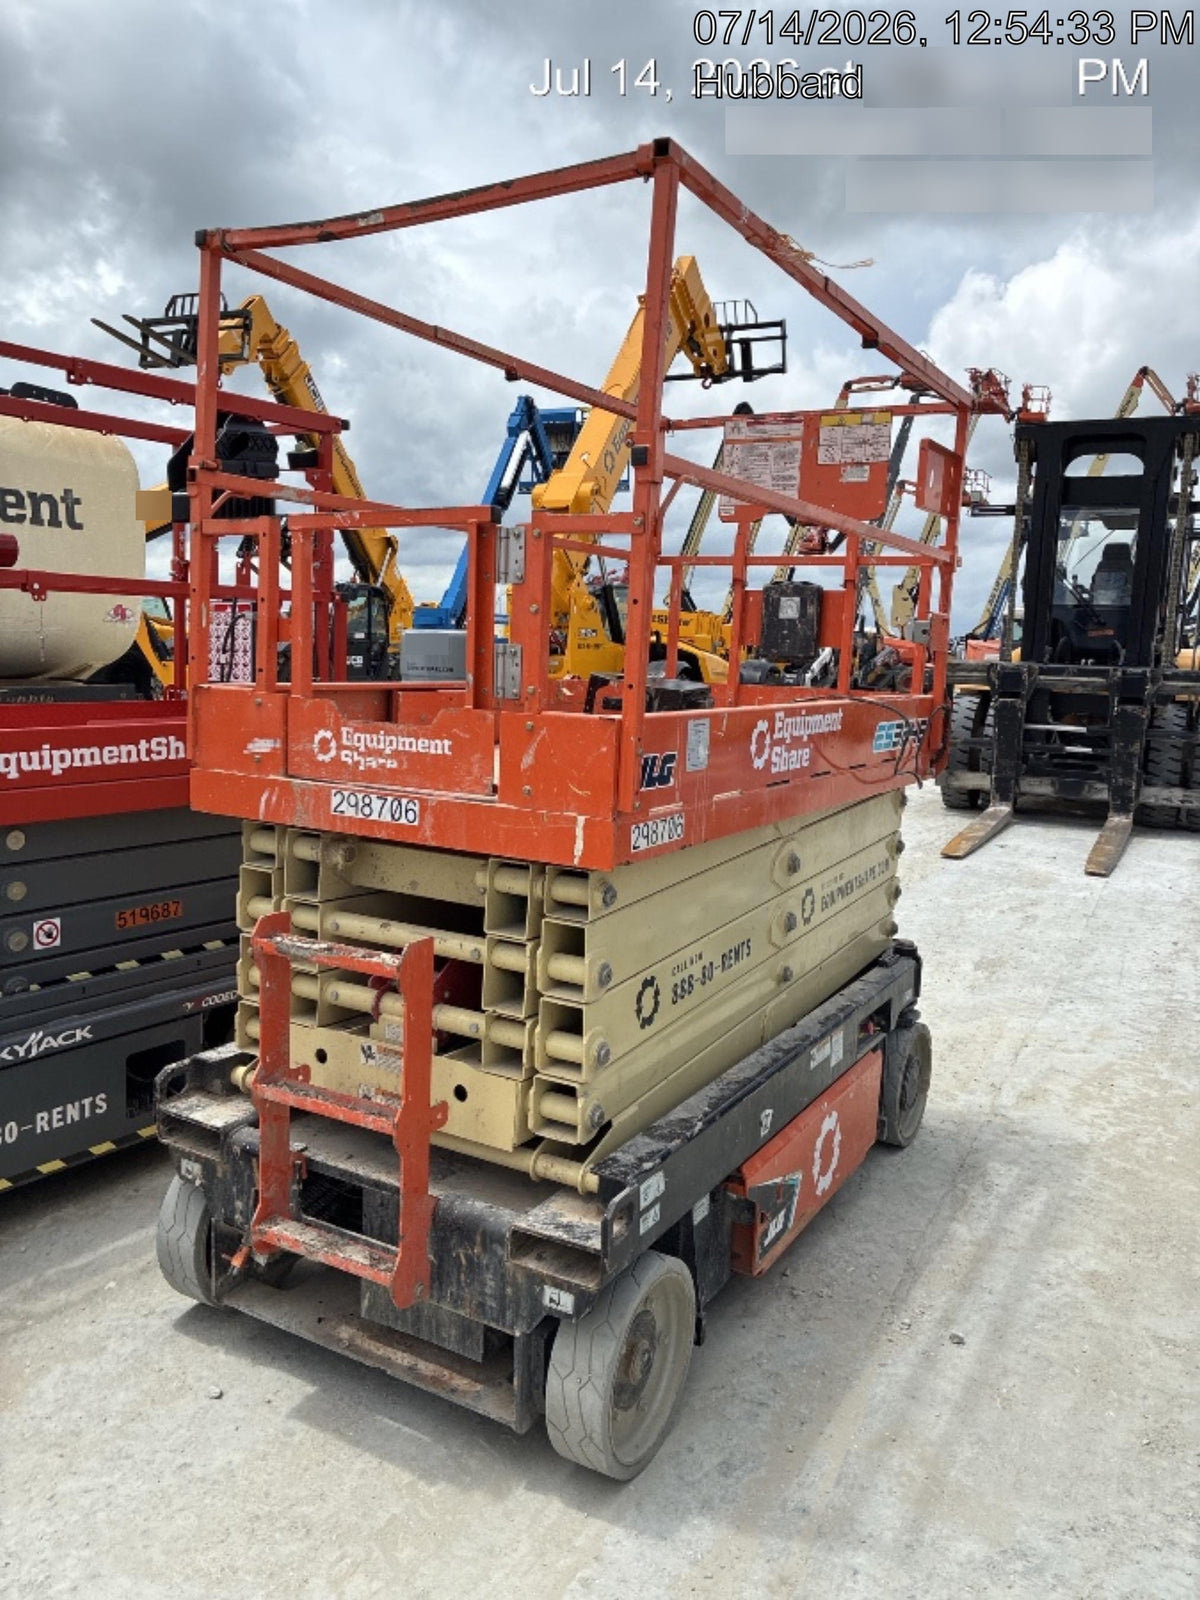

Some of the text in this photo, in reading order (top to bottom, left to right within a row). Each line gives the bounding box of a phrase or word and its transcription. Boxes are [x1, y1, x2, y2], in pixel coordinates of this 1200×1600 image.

[341, 727, 453, 755] Equipment
[773, 708, 843, 743] Equipment
[771, 744, 810, 774] Share
[333, 790, 417, 824] 298706
[632, 813, 683, 850] 298706
[117, 900, 181, 929] 519687
